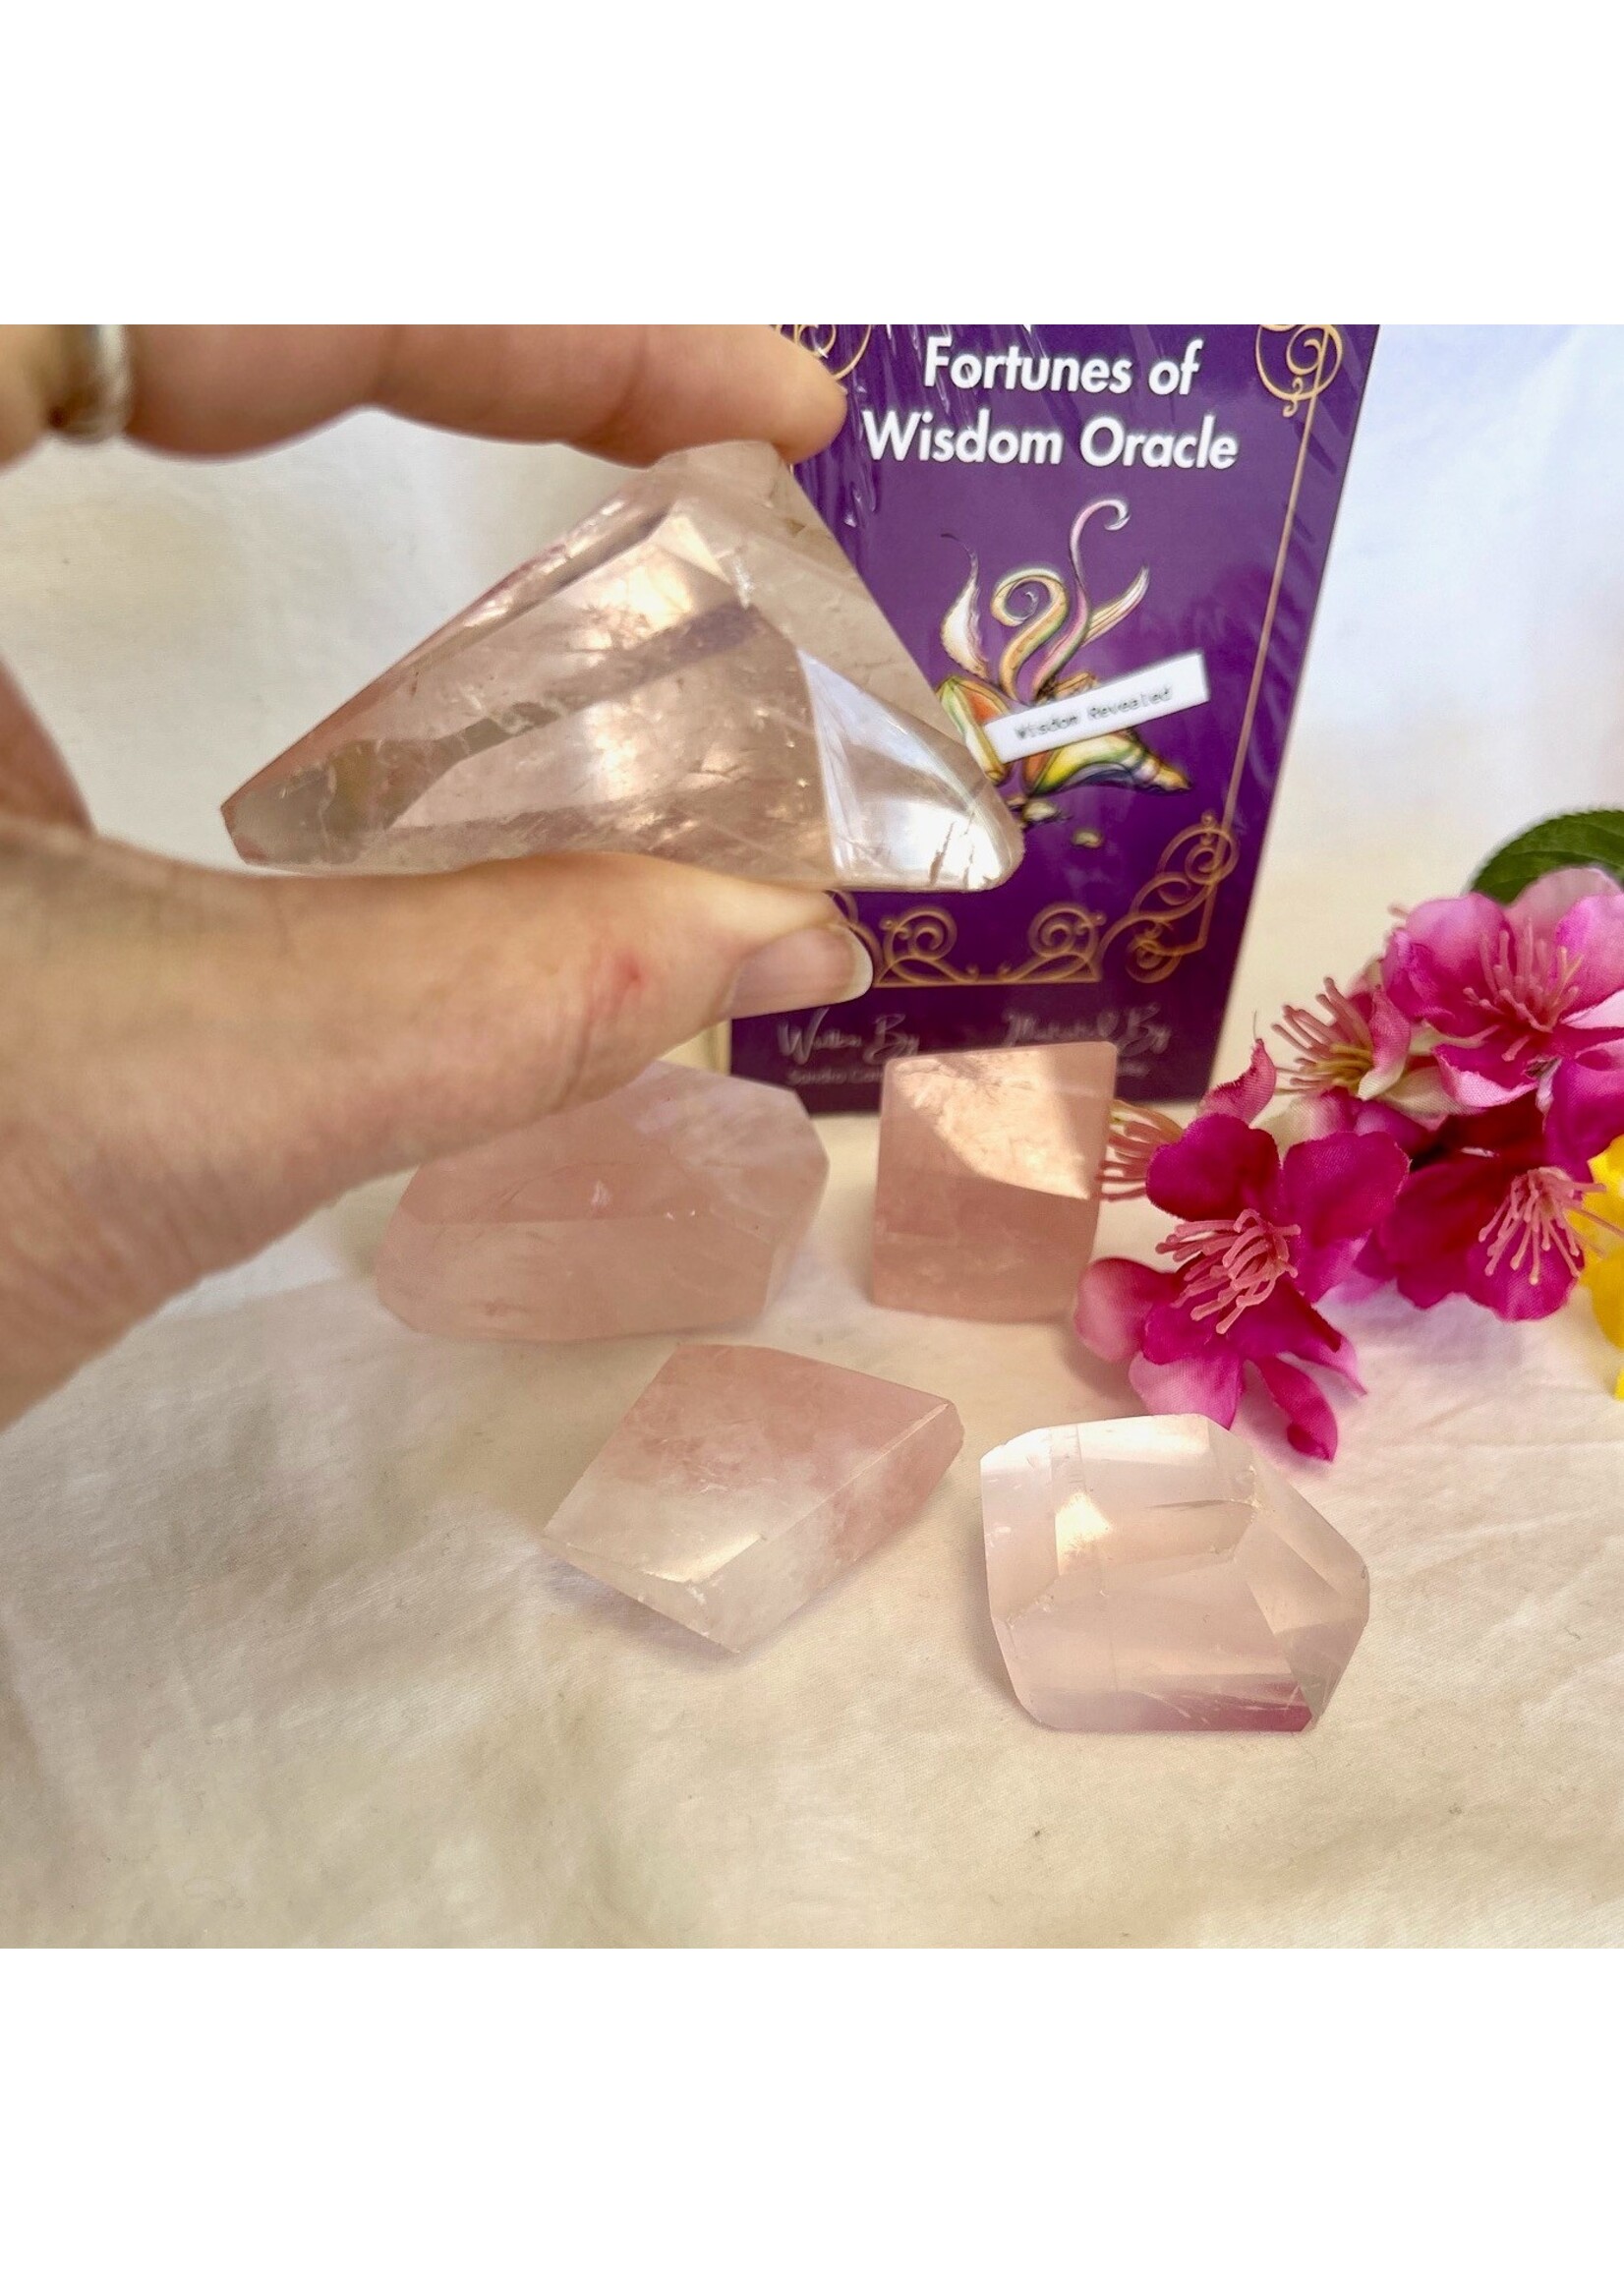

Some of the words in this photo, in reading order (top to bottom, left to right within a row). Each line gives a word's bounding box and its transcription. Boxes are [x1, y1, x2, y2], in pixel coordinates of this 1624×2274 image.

[923, 335, 1133, 395] Fortunes
[1146, 338, 1204, 395] of
[861, 407, 1064, 466] Wisdom
[1080, 414, 1240, 470] Oracle
[1015, 712, 1078, 739] Wisdom
[1086, 684, 1173, 721] Revealed
